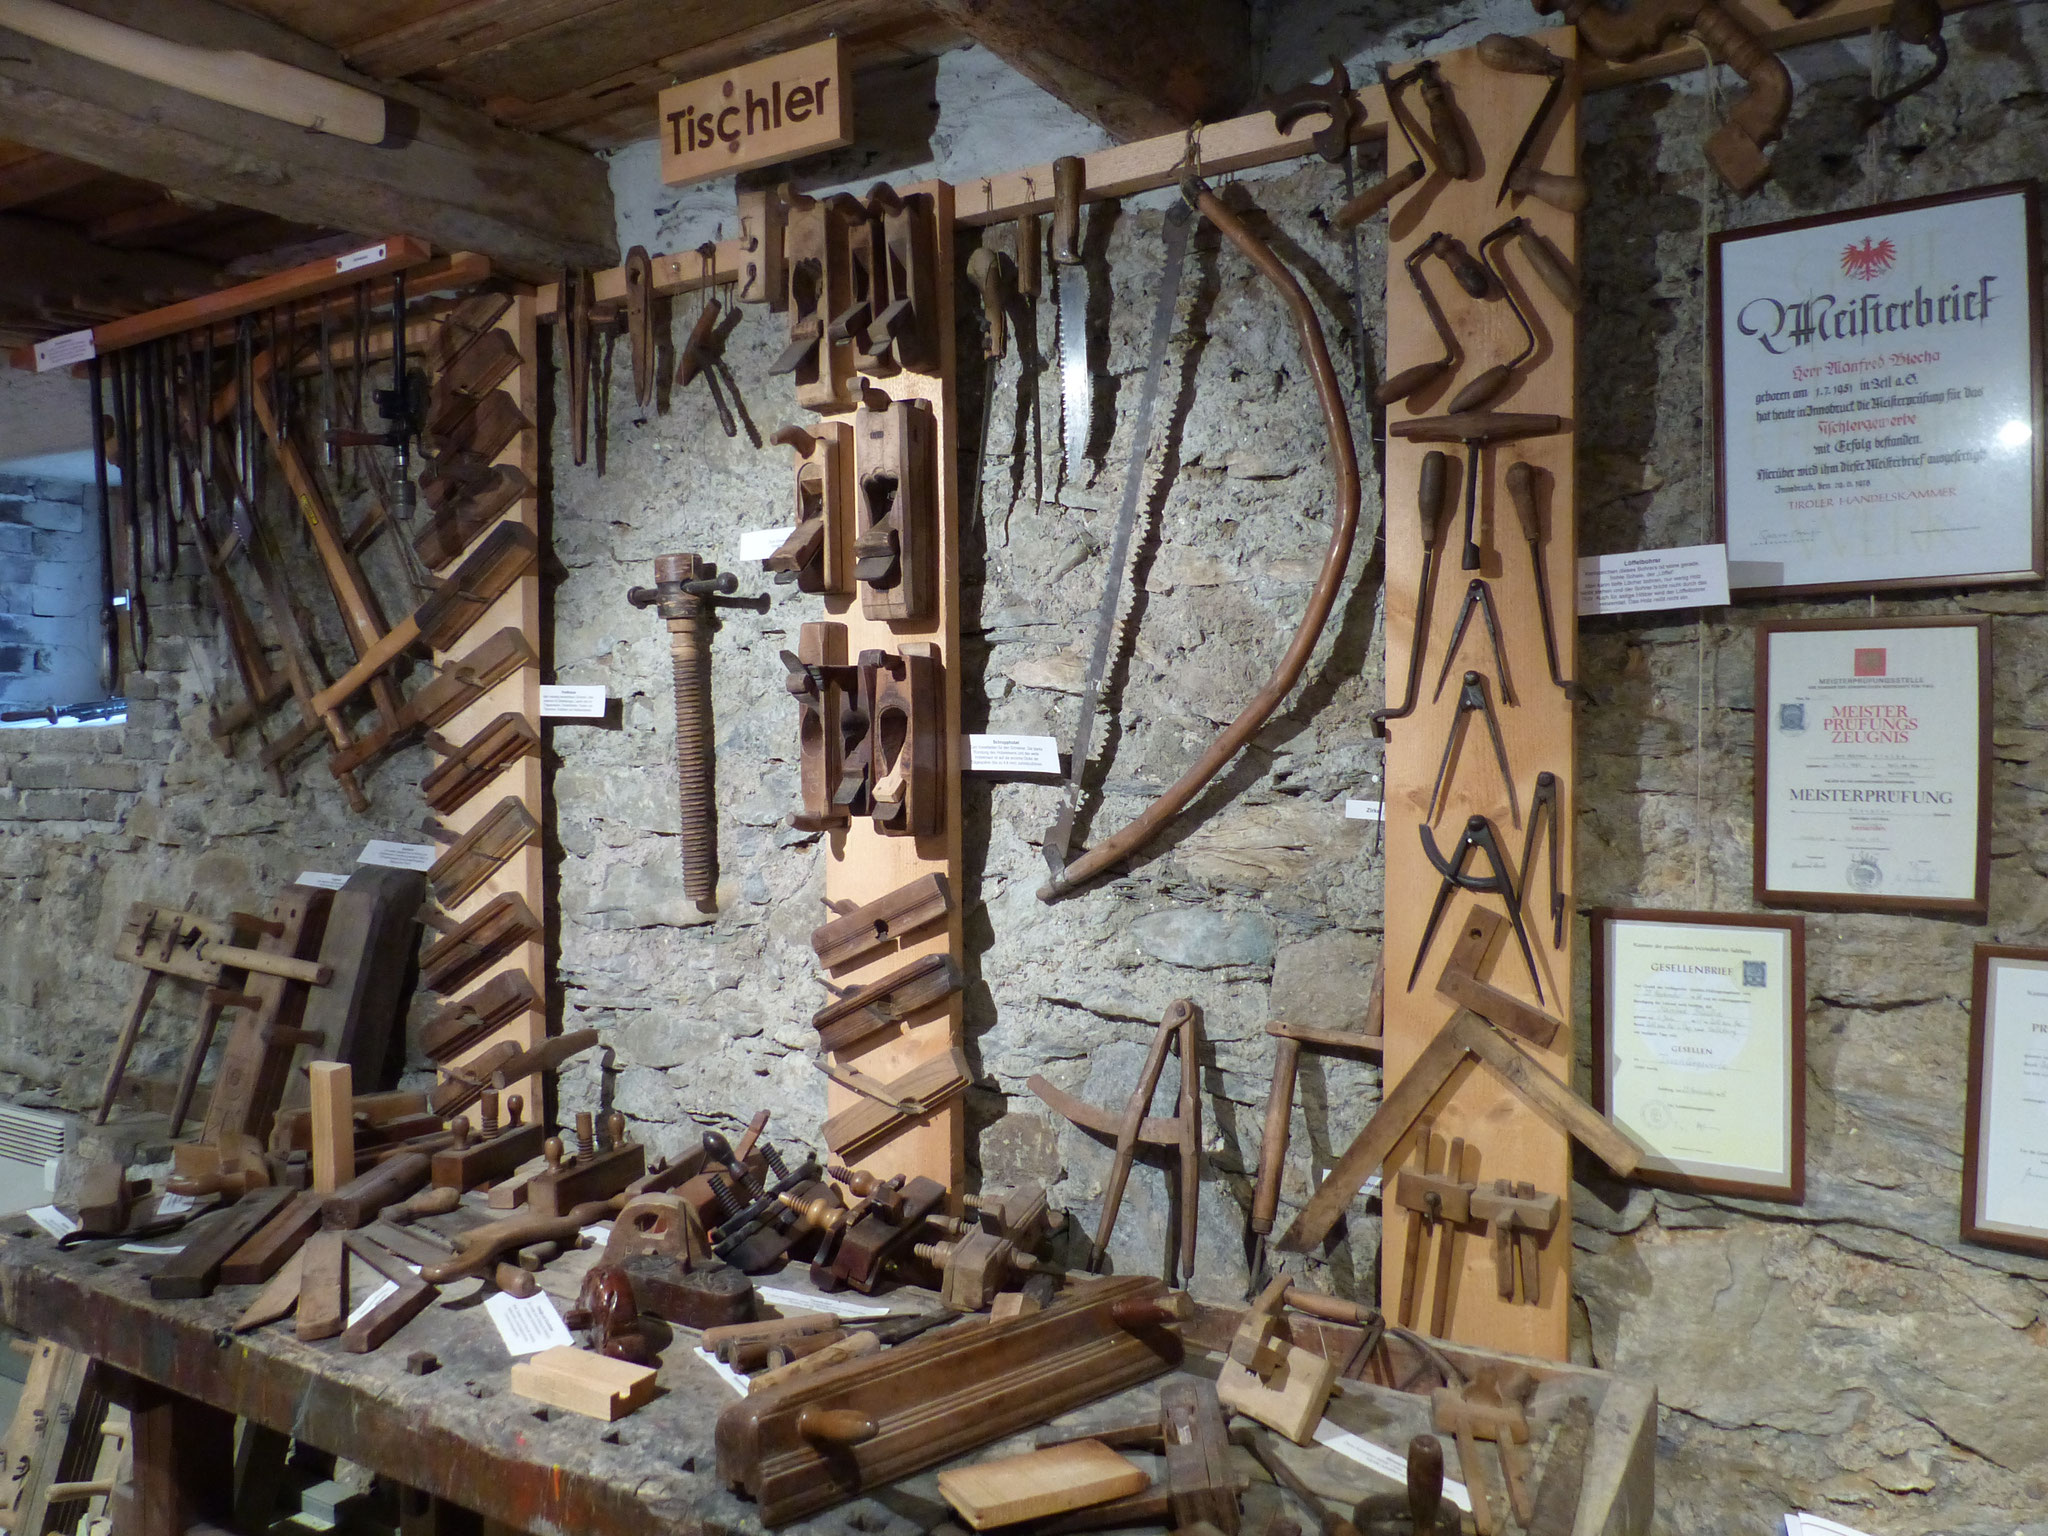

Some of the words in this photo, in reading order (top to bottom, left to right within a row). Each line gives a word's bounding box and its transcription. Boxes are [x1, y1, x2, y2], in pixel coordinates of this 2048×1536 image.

[667, 77, 831, 155] Tischler
[1737, 276, 1999, 354] Meisterbrief
[1792, 366, 1822, 381] Herr
[1825, 356, 1885, 375] Manfred
[1755, 390, 1790, 405] geboren
[1793, 389, 1808, 399] am
[1756, 411, 1770, 423] hat
[1772, 409, 1795, 420] heute
[1806, 401, 1854, 416] Innsbruck
[1857, 399, 1870, 411] die
[1813, 443, 1830, 455] mit
[1834, 439, 1872, 453] Erfolg
[1797, 464, 1819, 477] wird
[1820, 463, 1839, 475] ihm
[1840, 460, 1865, 474] dieser
[1865, 453, 1927, 471] Meisterbrief
[1789, 498, 1834, 510] TIROLER
[1839, 487, 1957, 506] HANDELSKAMMER
[1832, 705, 1910, 718] MEISTER
[1831, 731, 1910, 744] ZEUGNIS
[1650, 962, 1733, 976] GESELLENBRIEF
[1671, 1045, 1713, 1055] GESELLEN
